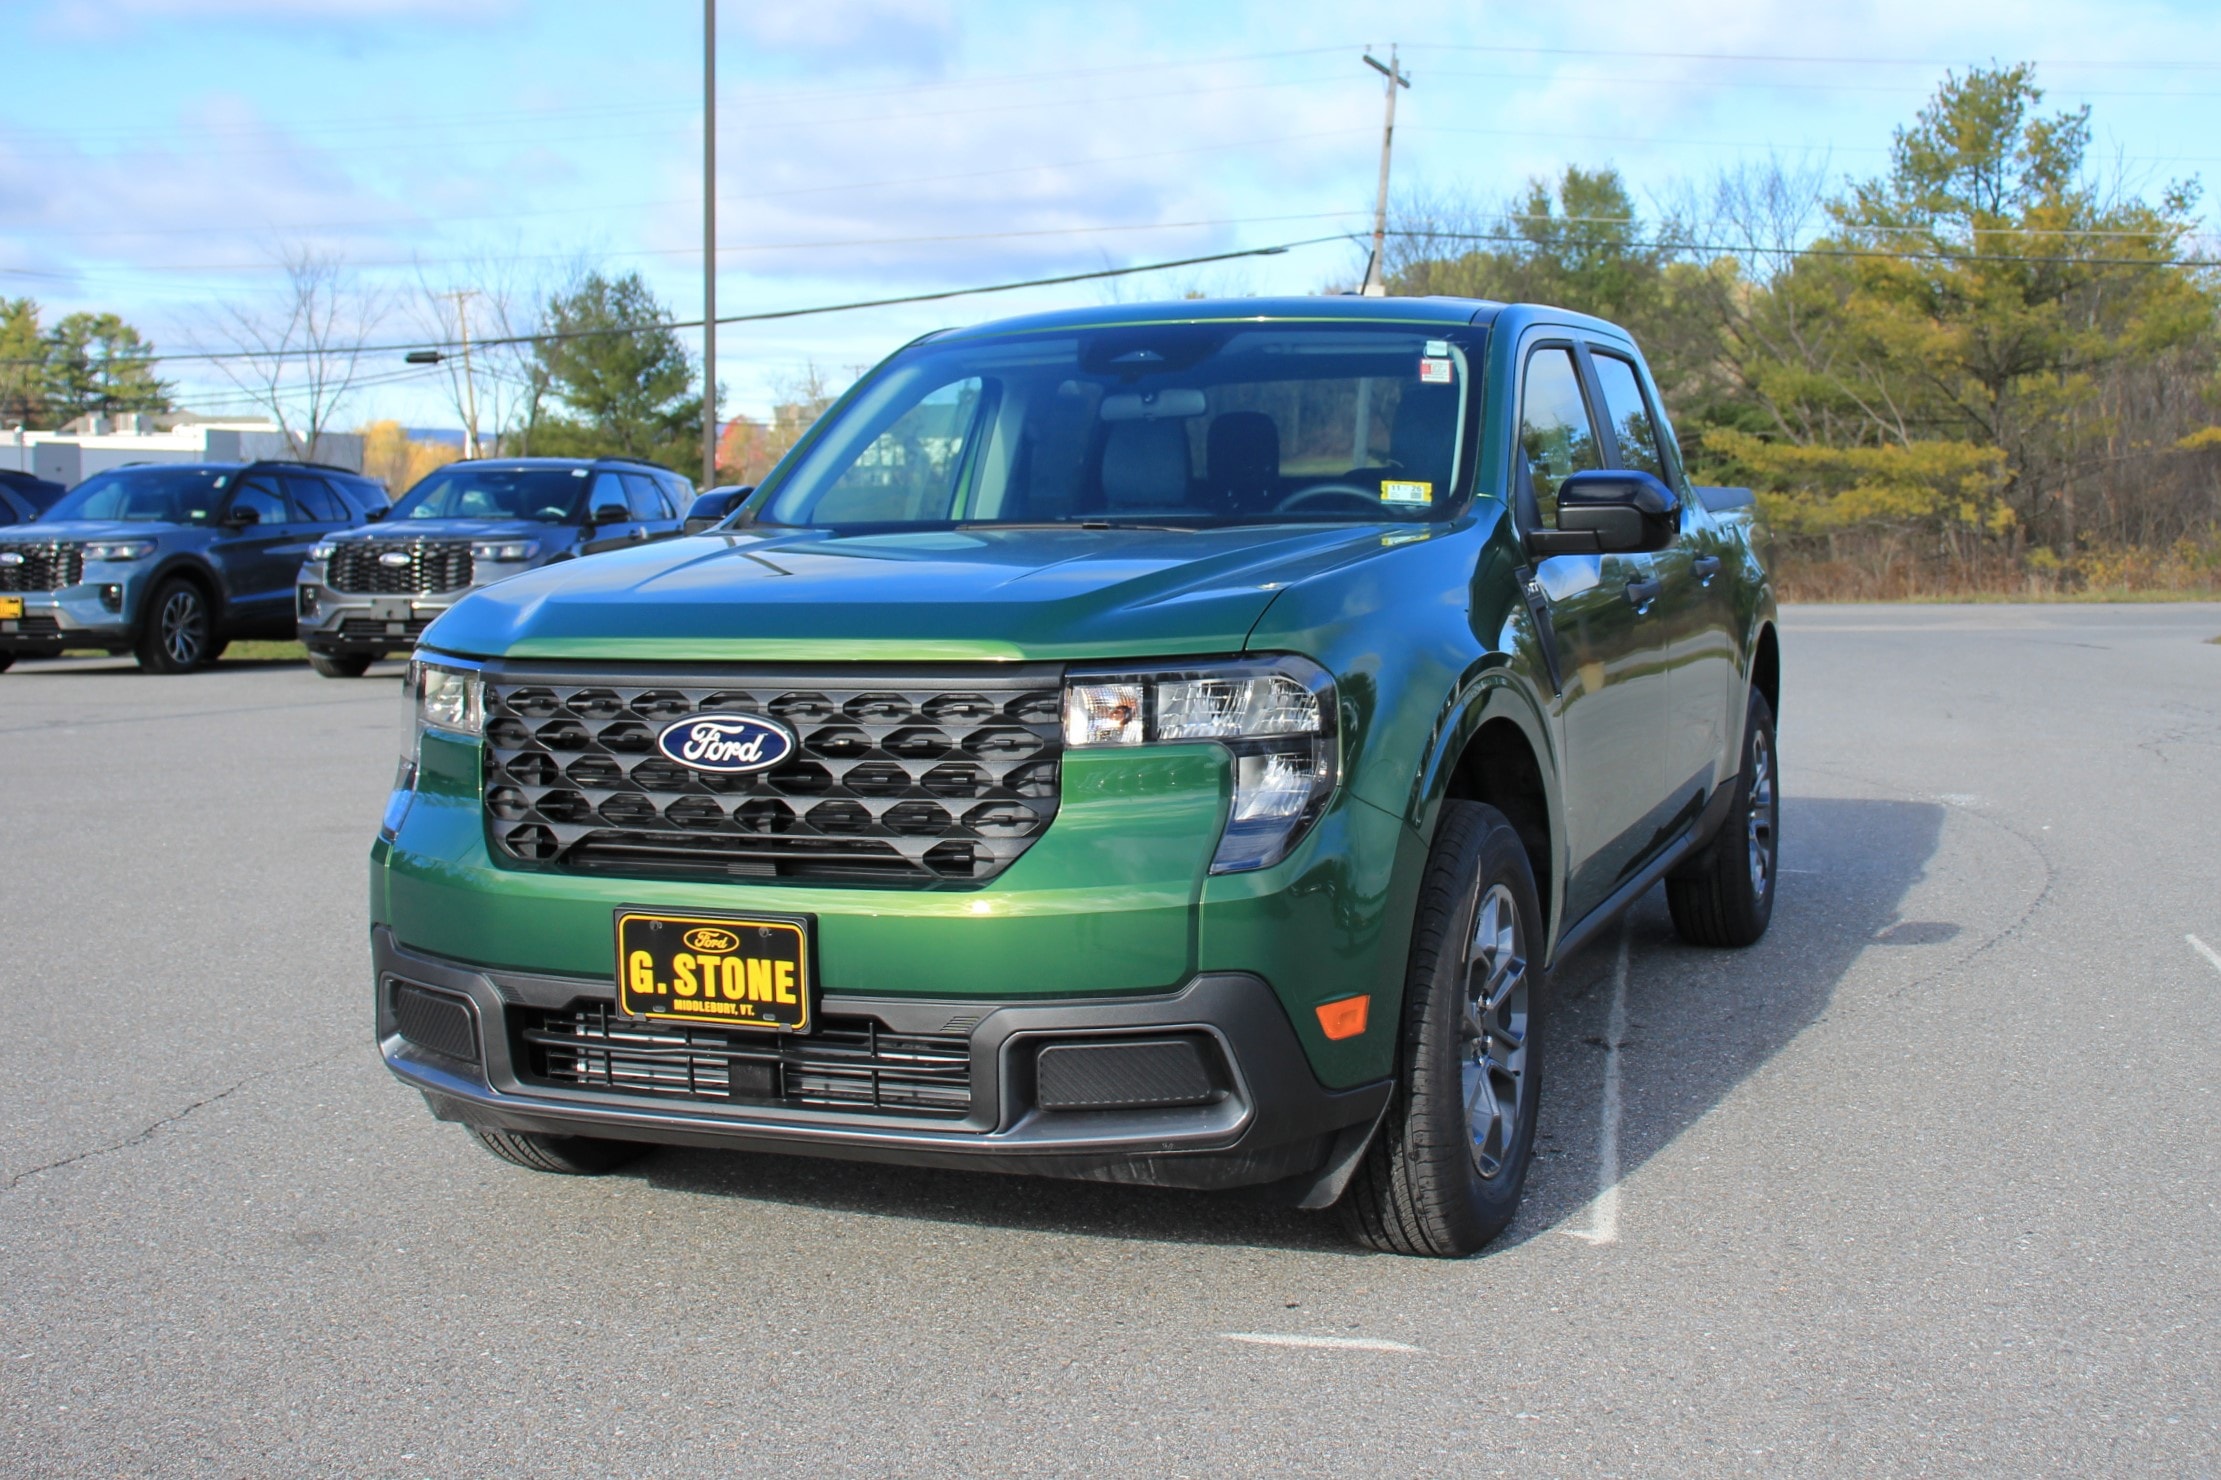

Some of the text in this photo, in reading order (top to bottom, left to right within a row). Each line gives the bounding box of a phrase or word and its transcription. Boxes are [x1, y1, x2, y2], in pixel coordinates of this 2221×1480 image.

[683, 722, 769, 762] Ford
[694, 930, 729, 949] Ford
[629, 951, 796, 1004] G. STONE
[673, 999, 755, 1016] MIDDLEBURY, VT.
